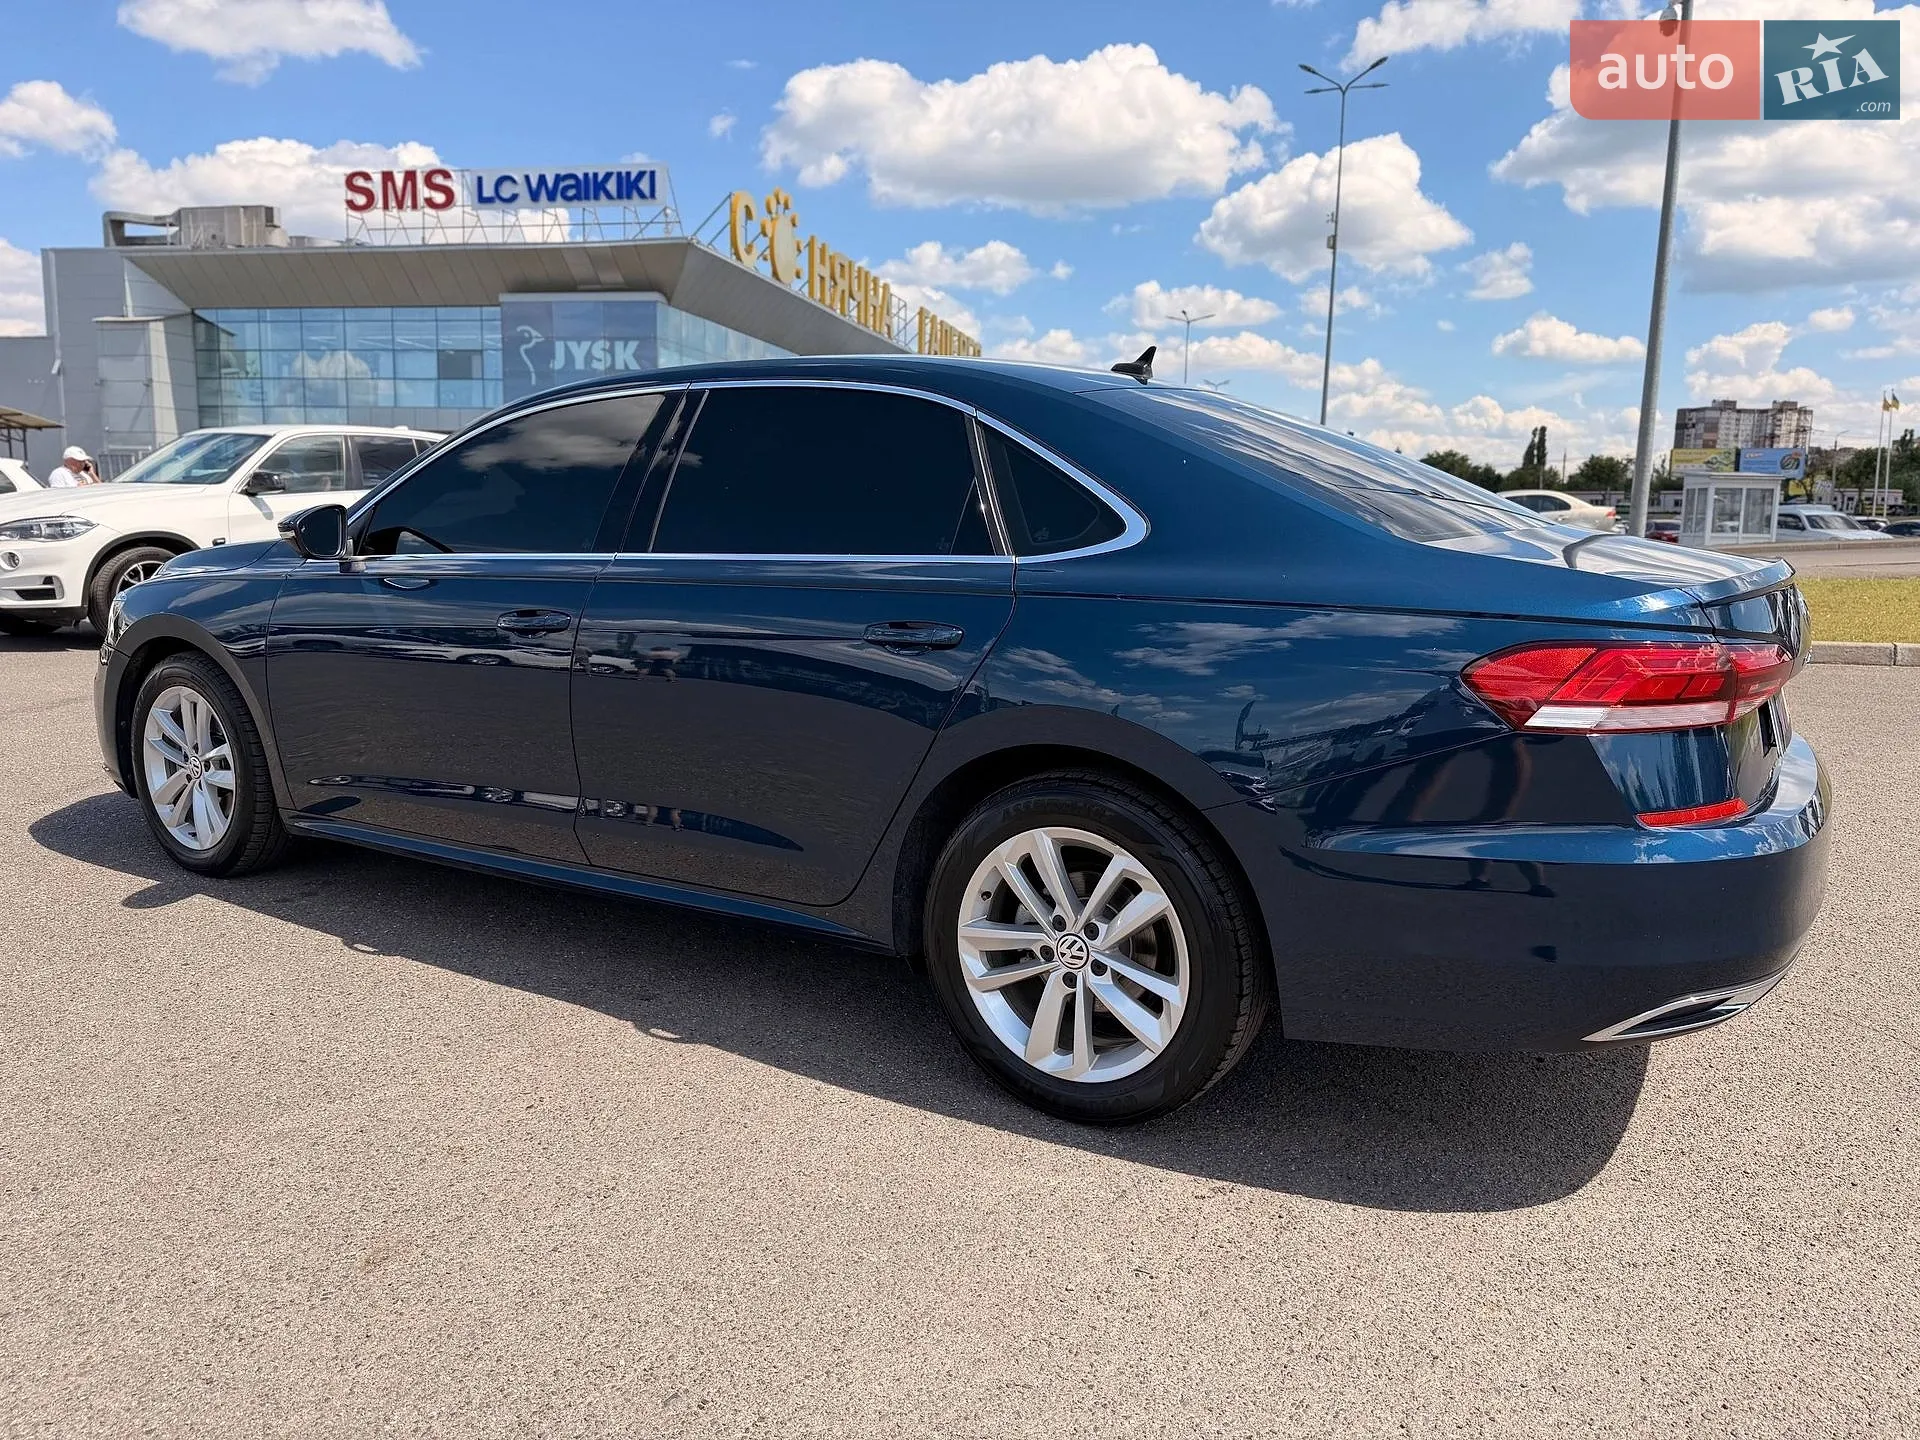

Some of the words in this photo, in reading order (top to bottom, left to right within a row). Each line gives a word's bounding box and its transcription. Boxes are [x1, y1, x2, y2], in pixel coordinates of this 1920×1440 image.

[345, 168, 455, 211] SMS
[477, 175, 519, 204] LC
[550, 340, 641, 371] JYSK
